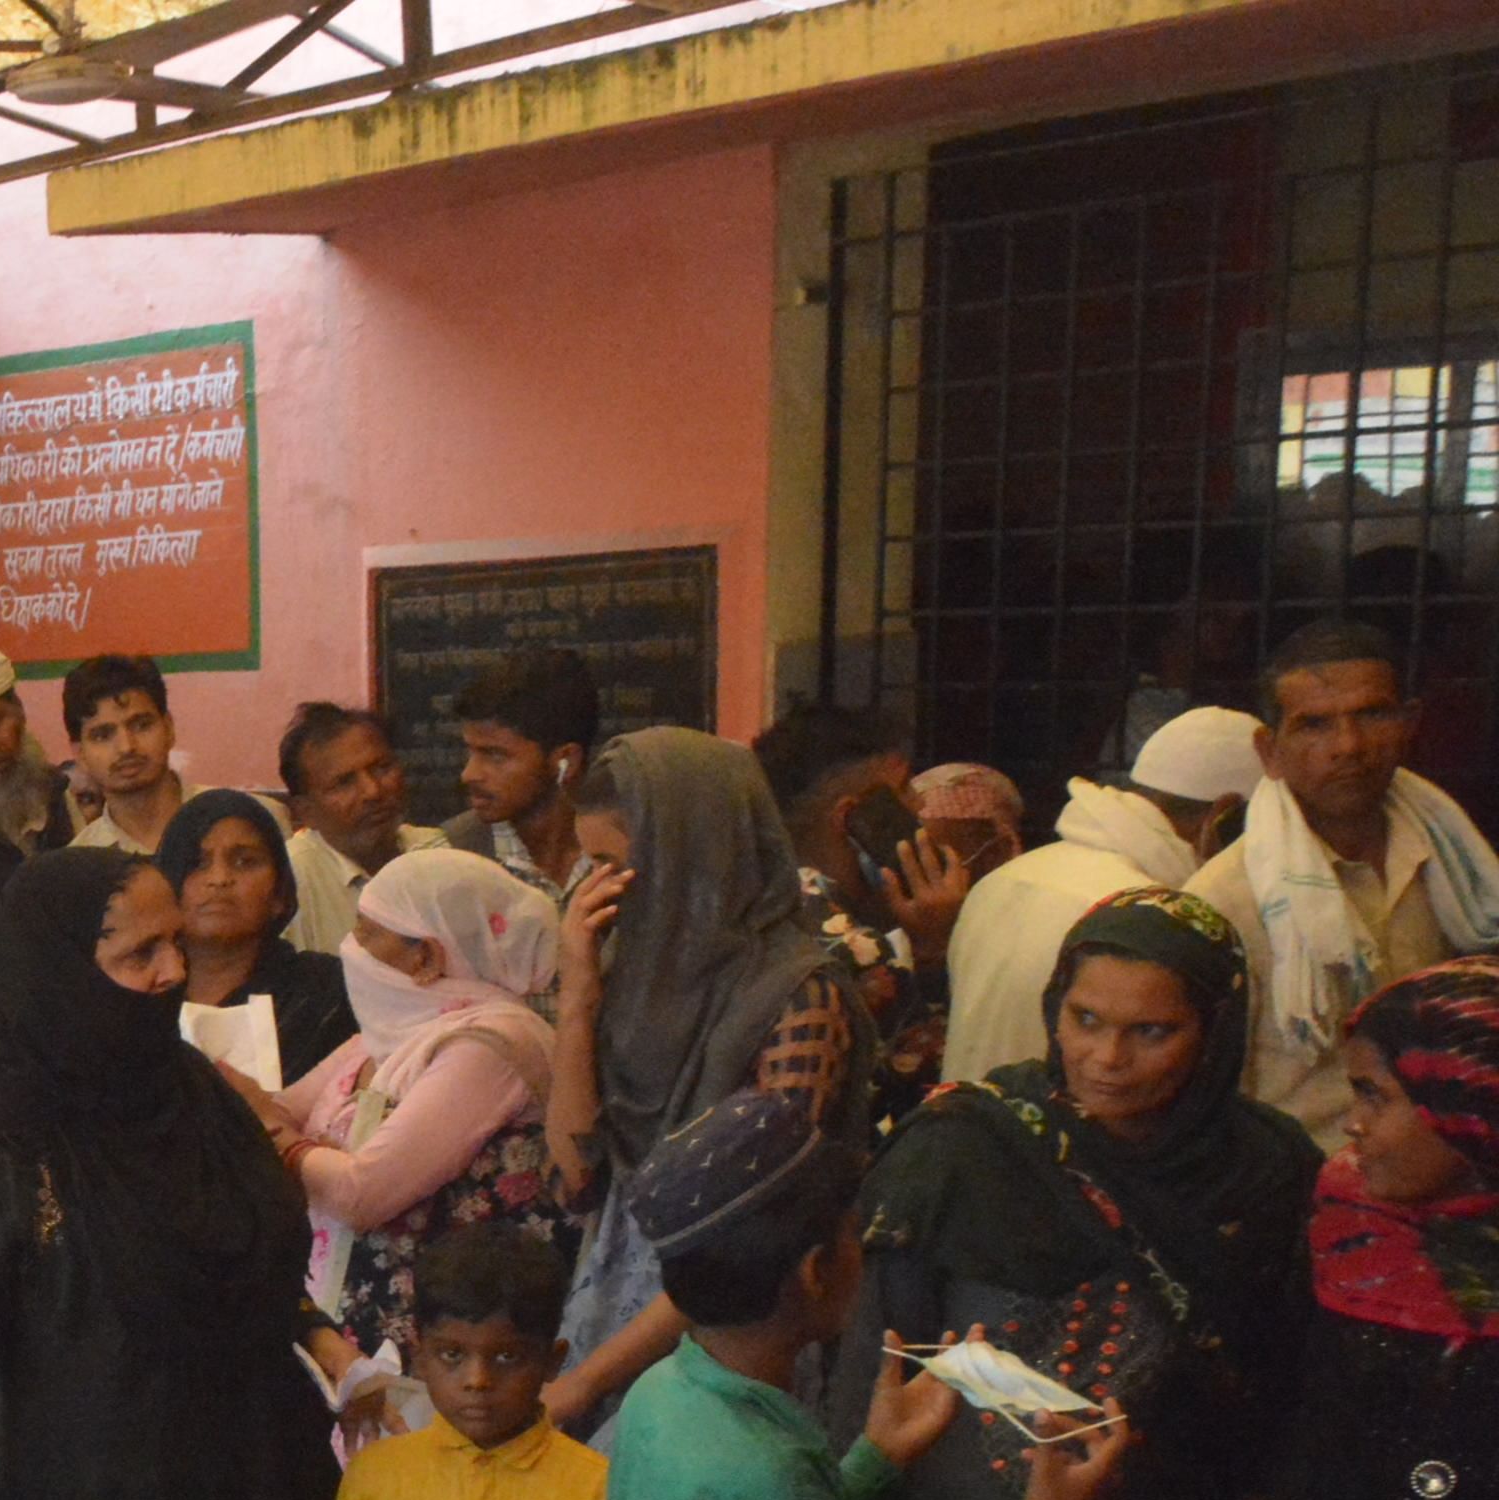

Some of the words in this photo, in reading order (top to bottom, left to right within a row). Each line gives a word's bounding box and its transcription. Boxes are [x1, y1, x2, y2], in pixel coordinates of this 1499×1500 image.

[106, 372, 151, 420] किसी
[59, 435, 83, 479] को
[147, 435, 164, 472] न
[38, 497, 73, 536] द्वारा
[73, 481, 113, 528] किसी
[2, 545, 45, 583] सूचना
[95, 535, 133, 577] मुख्य
[132, 522, 203, 569] चिकित्सा
[44, 580, 67, 623] को
